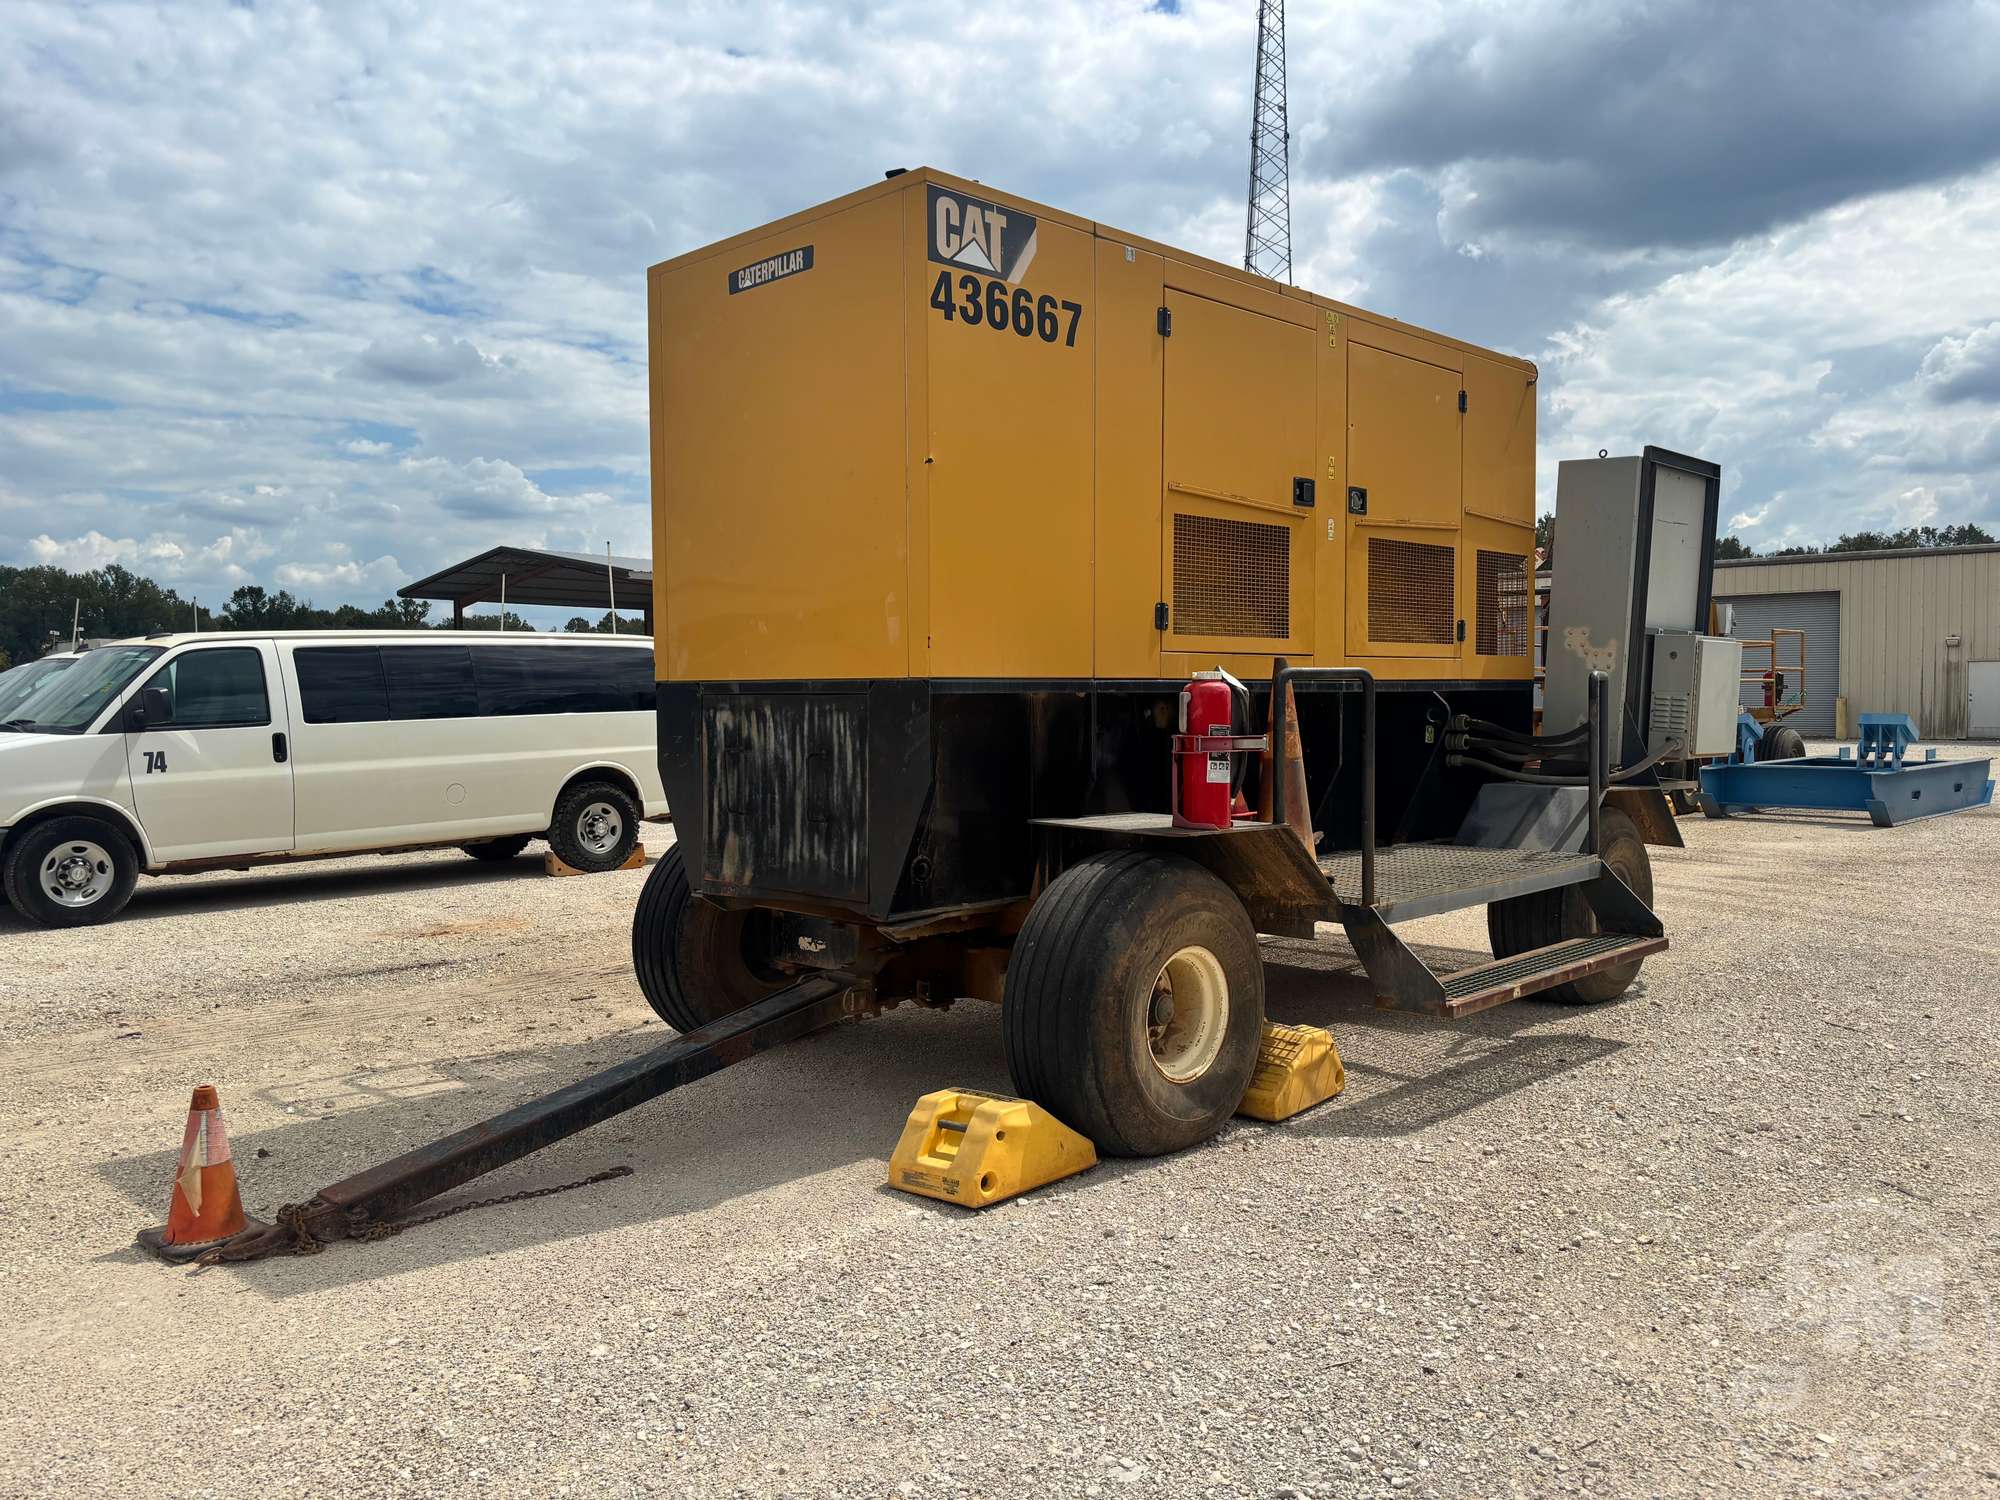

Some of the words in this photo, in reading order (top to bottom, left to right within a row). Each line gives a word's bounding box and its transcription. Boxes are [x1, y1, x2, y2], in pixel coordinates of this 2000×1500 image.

[936, 195, 1007, 273] CAT
[738, 249, 804, 289] CATERPILLAR
[930, 270, 1082, 347] 436667
[143, 751, 168, 774] 74
